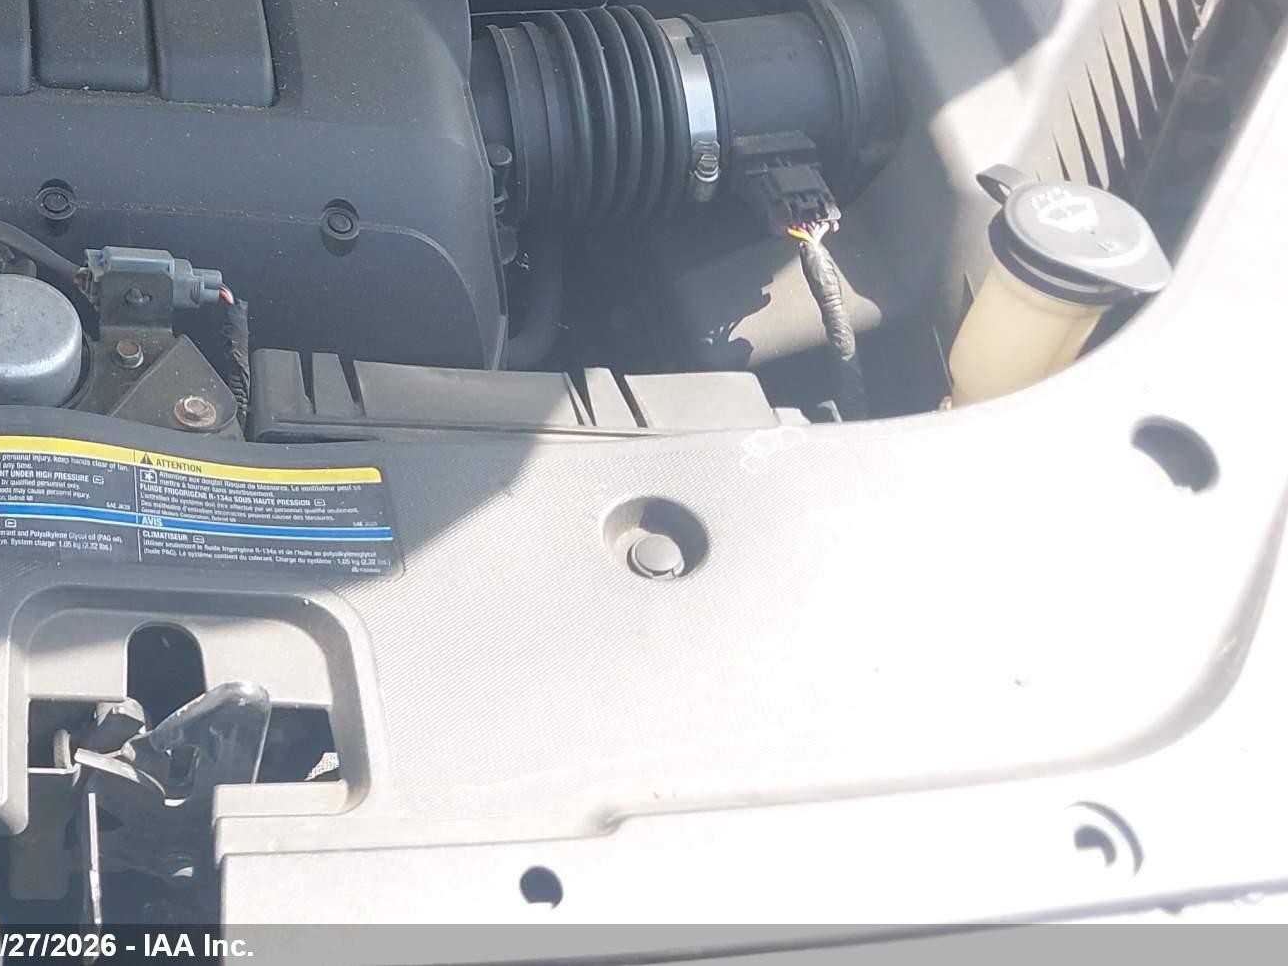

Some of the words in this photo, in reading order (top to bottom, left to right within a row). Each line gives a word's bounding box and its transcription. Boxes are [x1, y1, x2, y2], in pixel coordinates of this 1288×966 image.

[2, 454, 30, 462] personal
[54, 455, 70, 464] keep
[92, 459, 108, 468] clear
[2, 463, 15, 471] any
[156, 458, 202, 473] ATTENTION
[36, 470, 52, 479] HIGH
[54, 472, 89, 482] PRESSURE
[140, 483, 162, 493] FLUIDE
[254, 498, 275, 506] HAUTE
[142, 517, 164, 526] AVIS
[142, 530, 188, 541] CLIMATISEUR
